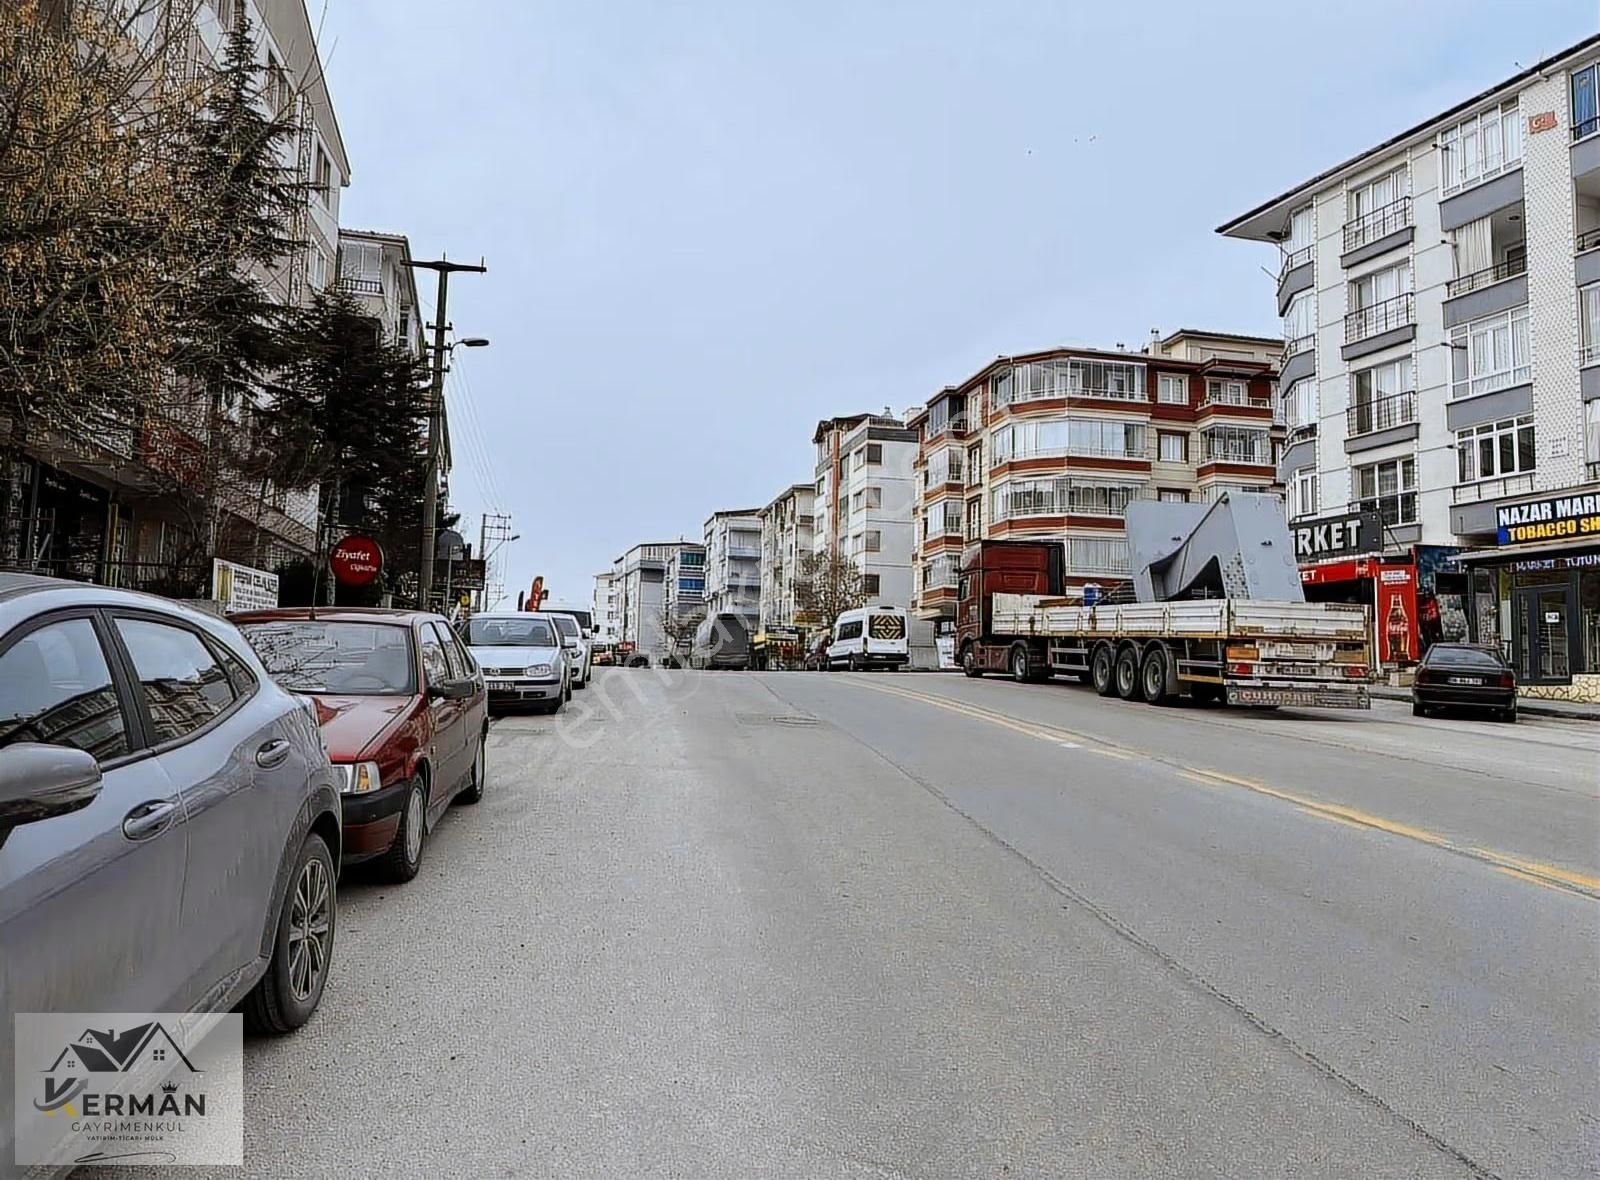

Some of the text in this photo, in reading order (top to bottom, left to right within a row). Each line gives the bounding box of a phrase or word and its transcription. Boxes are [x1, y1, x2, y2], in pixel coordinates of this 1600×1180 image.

[1498, 502, 1553, 526] NAZAR
[1297, 519, 1361, 556] RKET
[1508, 519, 1577, 541] TOBACCO
[335, 548, 370, 561] Ziyafet
